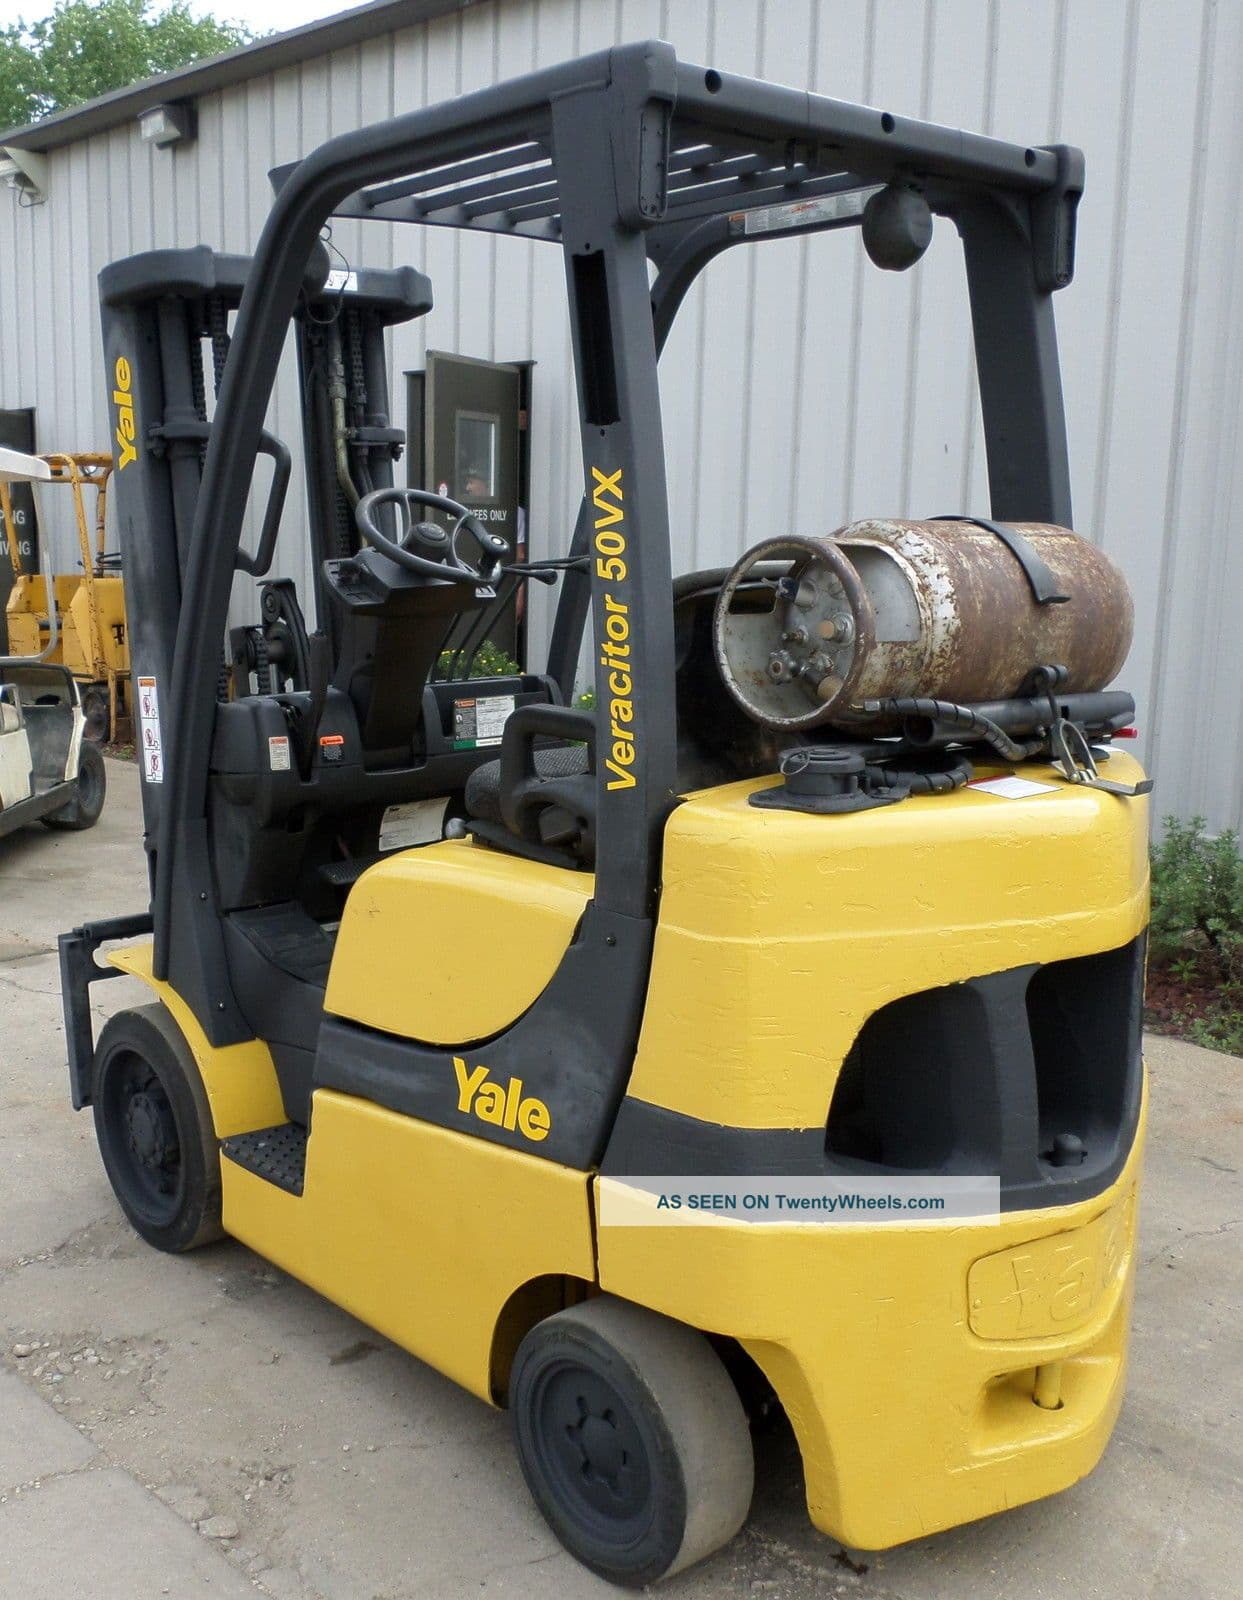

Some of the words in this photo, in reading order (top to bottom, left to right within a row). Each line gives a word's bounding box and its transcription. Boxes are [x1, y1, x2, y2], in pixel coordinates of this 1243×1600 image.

[113, 356, 137, 471] Yale
[489, 509, 508, 521] ONLY
[591, 466, 628, 582] 50VX
[600, 594, 637, 791] Veracitor
[453, 1056, 551, 1142] Yale
